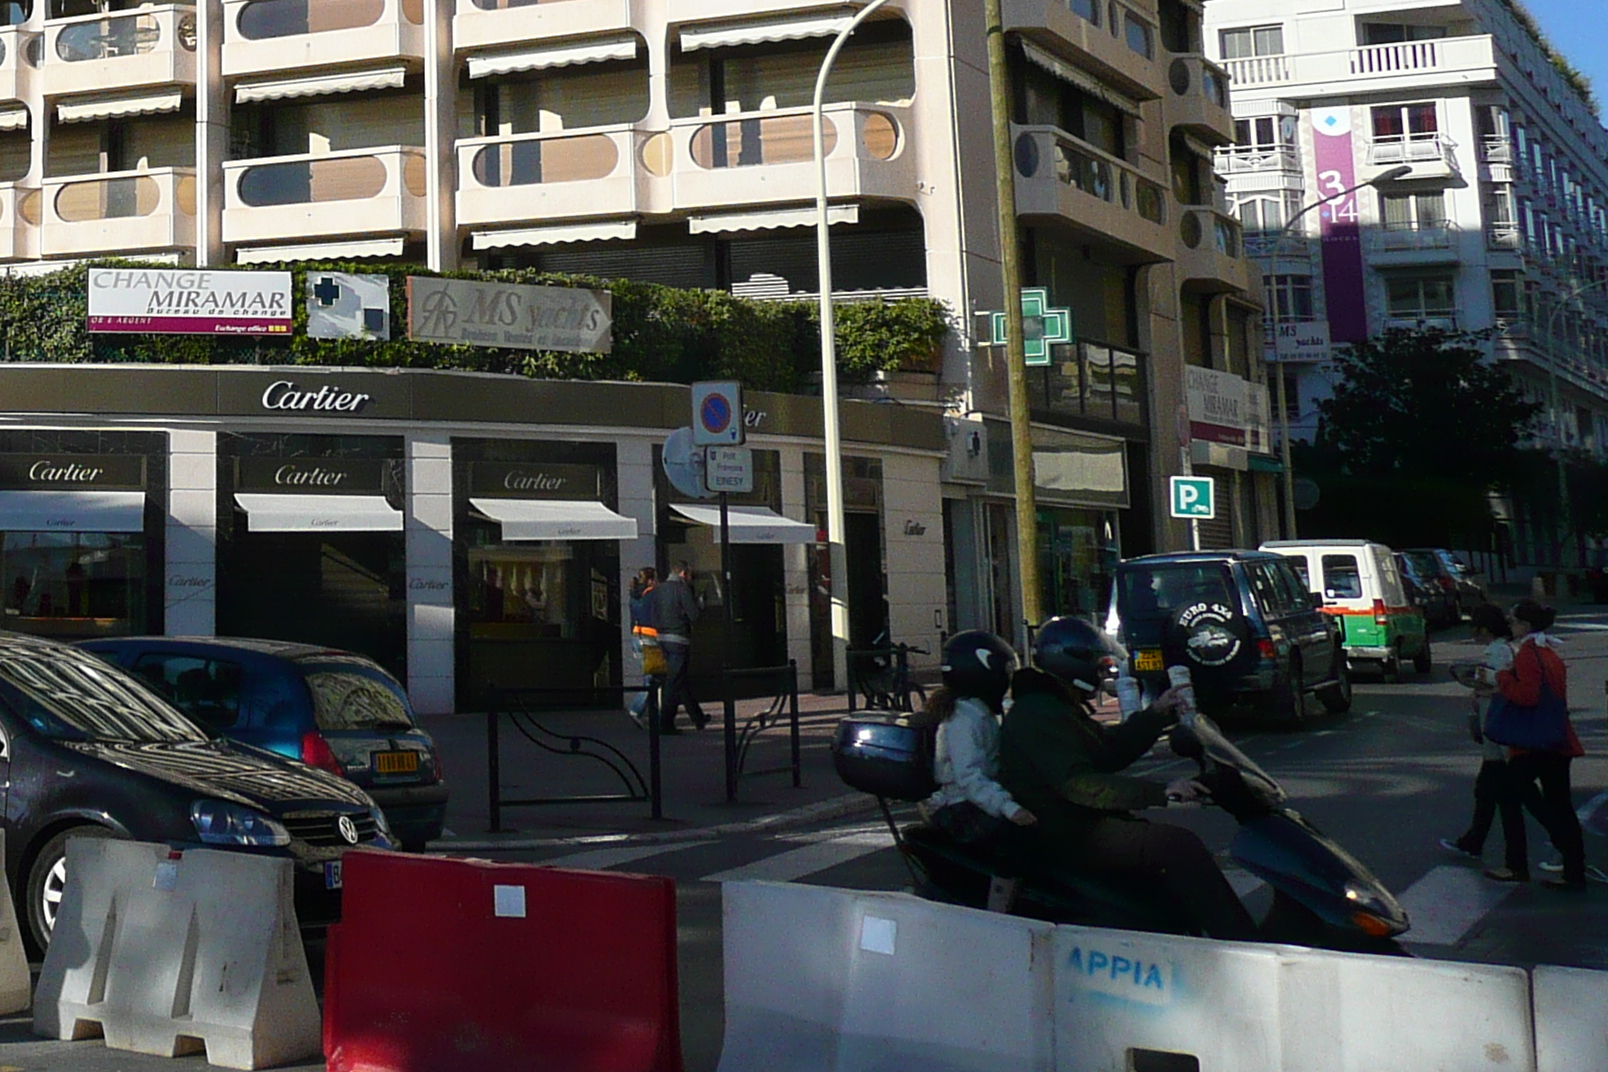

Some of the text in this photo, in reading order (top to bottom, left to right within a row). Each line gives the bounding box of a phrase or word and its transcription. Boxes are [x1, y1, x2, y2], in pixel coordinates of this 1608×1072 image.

[93, 272, 212, 290] CHANGE
[148, 291, 285, 309] MIRAMAR
[462, 289, 599, 332] MS yachts
[147, 307, 200, 315] Bureau
[233, 309, 286, 317] change
[1279, 325, 1298, 337] MS
[262, 380, 369, 411] Cartier
[29, 460, 103, 481] Cartier
[275, 464, 347, 486] Cartier
[504, 469, 567, 490] Cartier
[1179, 484, 1199, 510] P
[409, 578, 449, 591] Cartier
[1178, 602, 1207, 627] EURO
[1069, 945, 1163, 989] APPIA
